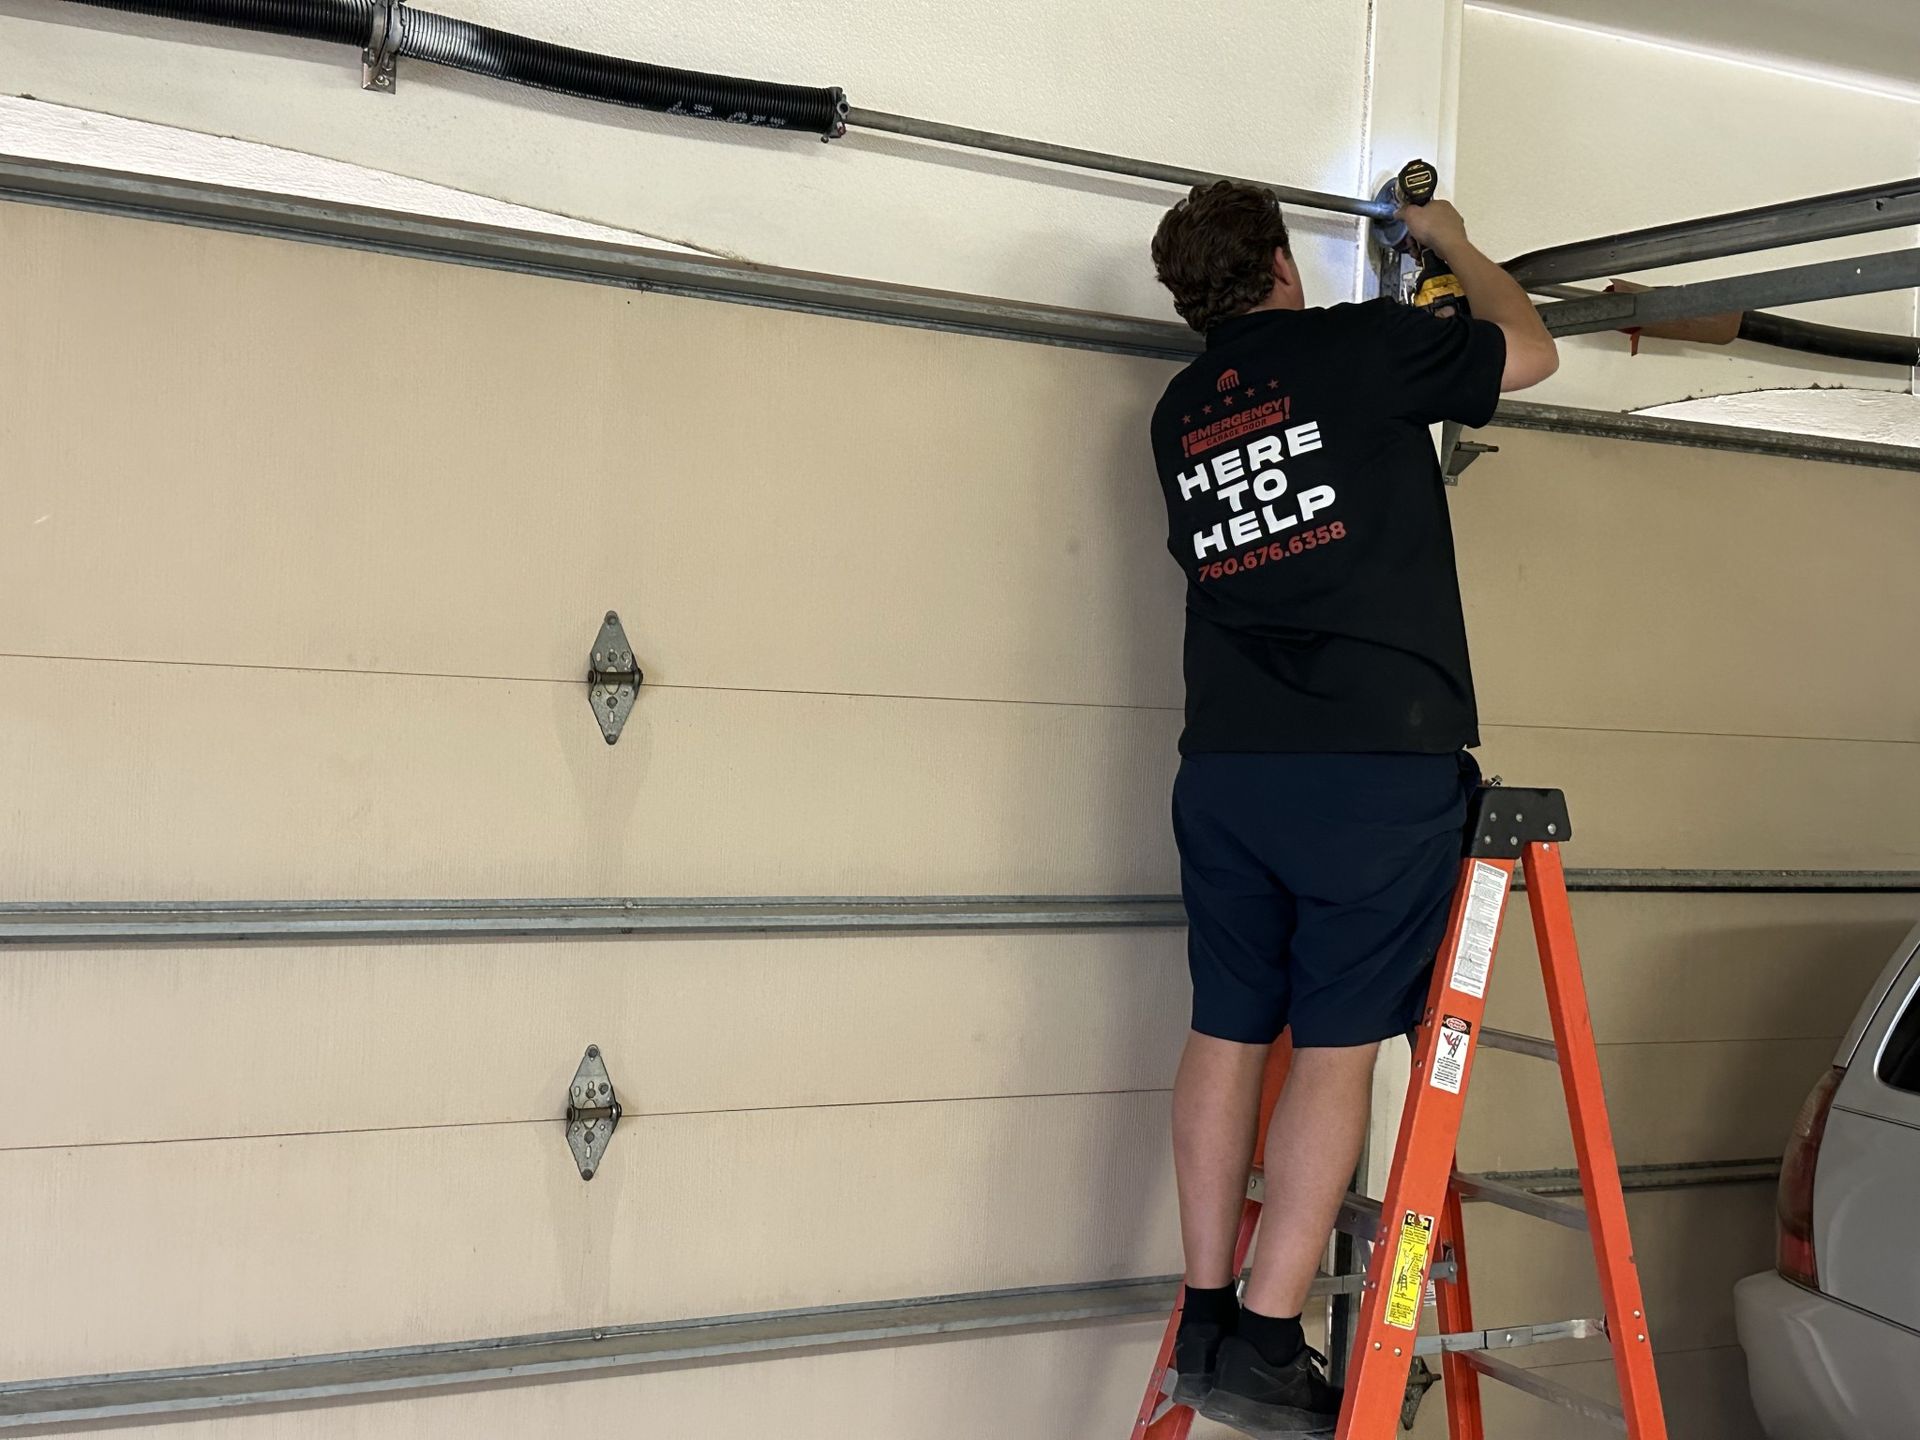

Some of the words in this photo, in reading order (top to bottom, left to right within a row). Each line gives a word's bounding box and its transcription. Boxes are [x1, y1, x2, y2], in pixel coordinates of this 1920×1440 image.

[1177, 421, 1323, 502] HERE
[1217, 468, 1288, 513] TO
[1193, 485, 1336, 560] HELP
[1198, 520, 1348, 583] 760.676.6358
